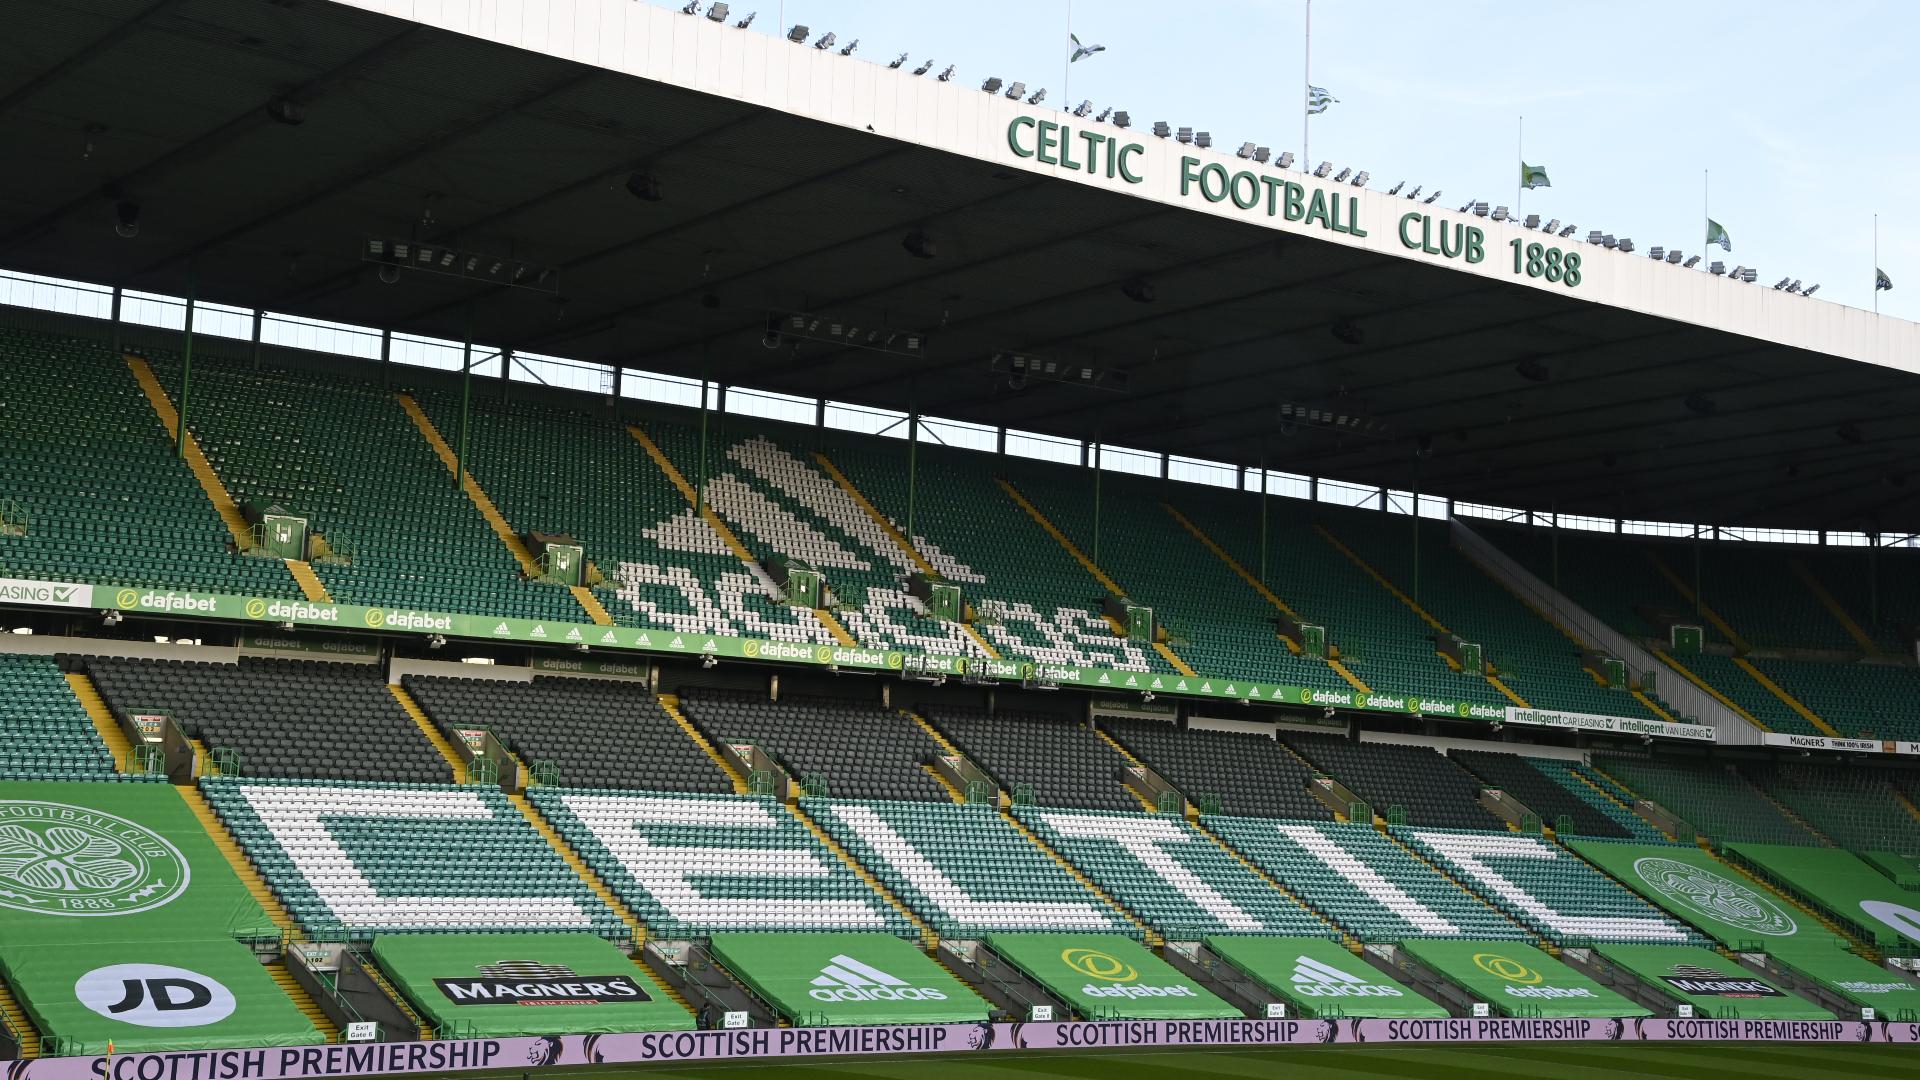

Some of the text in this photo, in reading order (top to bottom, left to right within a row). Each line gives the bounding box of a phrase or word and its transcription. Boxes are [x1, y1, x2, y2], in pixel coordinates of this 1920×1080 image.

[1008, 115, 1582, 287] CELTIC FOOTBALL CLUB 1888
[0, 585, 49, 600] ASING
[140, 590, 216, 611] dafabet
[267, 601, 338, 620] dafabet
[386, 610, 452, 629] dafabet
[760, 641, 812, 659] dafabet
[833, 648, 884, 665] dafabet
[1313, 690, 1350, 704] dafabet
[1367, 694, 1403, 709] dafabet
[1420, 699, 1455, 713] dafabet
[1470, 703, 1505, 718] dafabet
[1514, 709, 1605, 728] intelligent CAR LEASING
[1620, 719, 1705, 738] intelligent VAN LEASING
[1790, 736, 1825, 747] MAGNERS
[119, 830, 167, 858] CLUB
[239, 785, 1690, 942] CELTIC
[59, 898, 115, 908] 1888
[445, 981, 638, 999] MAGNERS
[809, 984, 948, 1001] adidas
[1082, 983, 1198, 999] dafabet
[1294, 982, 1403, 997] adidas
[1667, 979, 1775, 993] MAGNERS
[107, 978, 212, 1013] JD
[1056, 1021, 1299, 1046] SCOTTISH PREMIERSHIP
[1388, 1020, 1591, 1040] SCOTTISH PREMIERSHIP
[1667, 1020, 1843, 1041] SCOTTISH PREMIERSHIP
[642, 1027, 947, 1059] SCOTTISH PREMIERSHIP
[91, 1041, 500, 1080] SCOTTISH PREMIERSHIP
